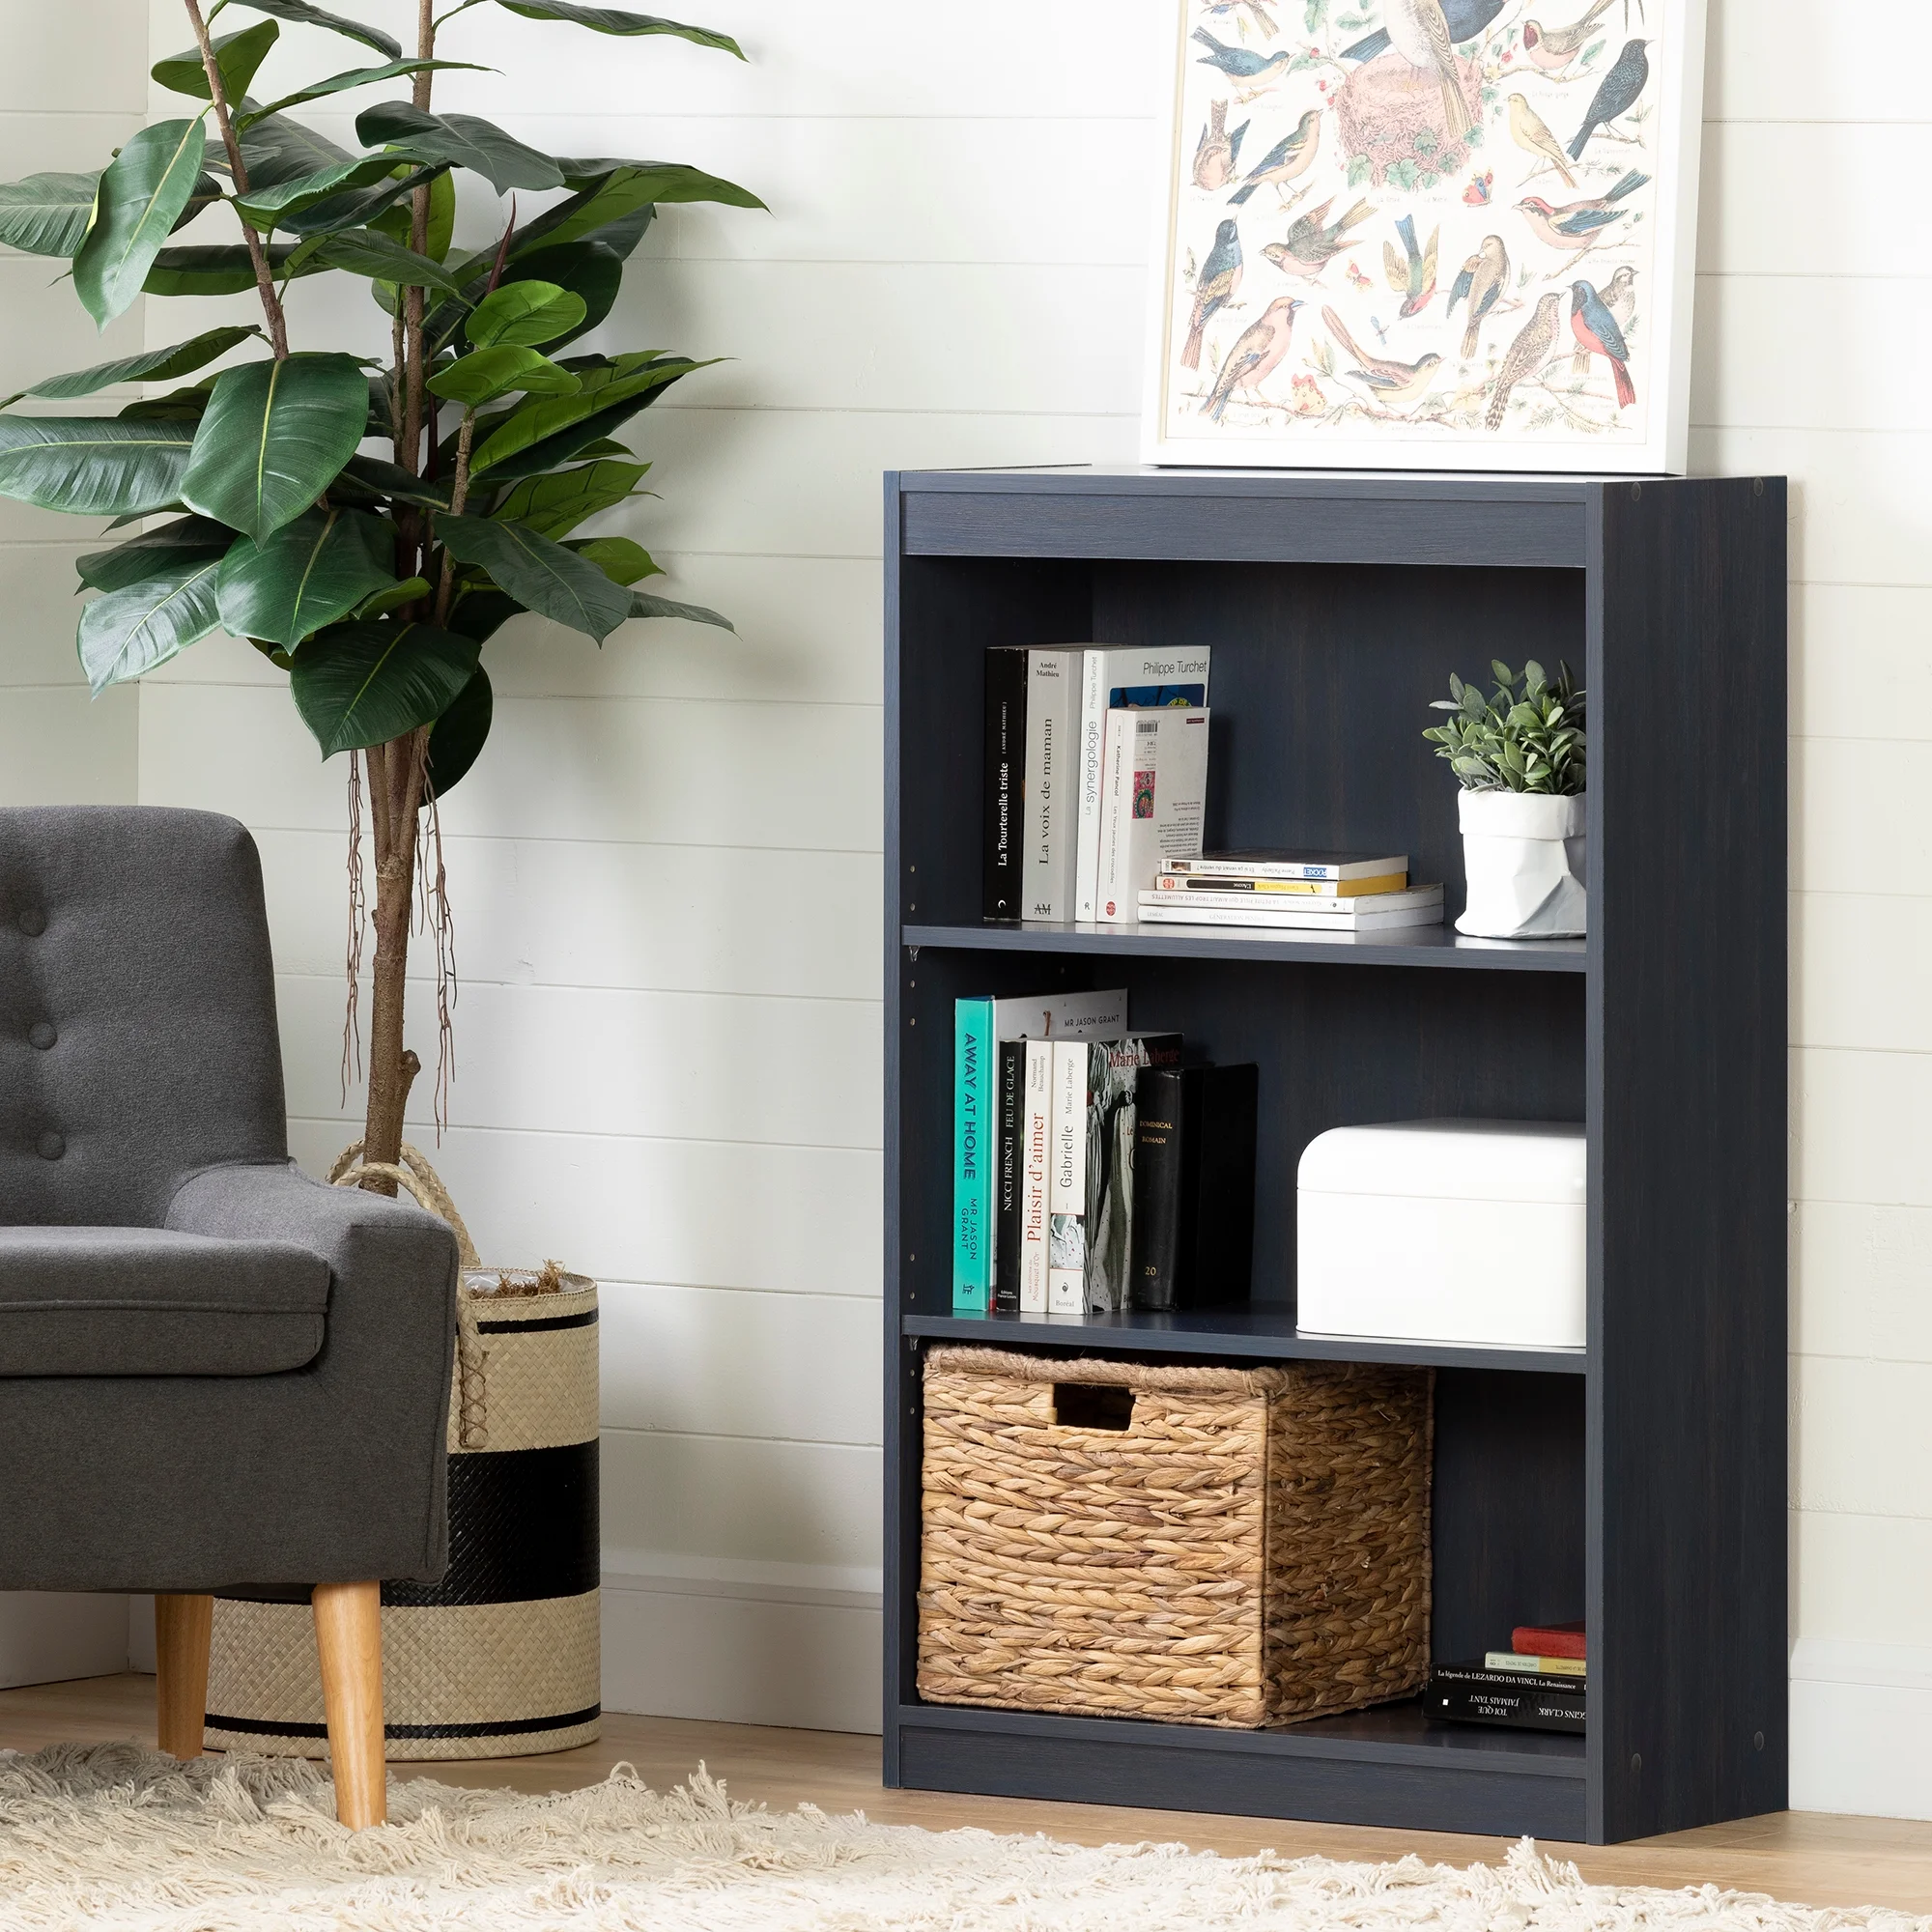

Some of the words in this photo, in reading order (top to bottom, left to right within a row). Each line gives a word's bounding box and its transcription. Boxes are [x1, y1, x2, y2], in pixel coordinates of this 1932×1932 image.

[1143, 662, 1175, 676] Philippe
[1177, 660, 1208, 673] Turchet
[1043, 719, 1052, 775] maman
[1086, 721, 1099, 803] synergologie
[999, 762, 1009, 790] triste
[1040, 781, 1051, 800] de
[1085, 806, 1092, 815] La
[998, 793, 1009, 850] Tourterelle
[1039, 805, 1050, 838] voix
[998, 853, 1008, 867] La
[1039, 844, 1049, 865] La
[1303, 867, 1326, 877] POCKET
[1064, 1018, 1074, 1027] MR
[1075, 1016, 1096, 1027] JASON
[1098, 1014, 1120, 1024] GRANT
[964, 1033, 978, 1090] AWAY
[1109, 1050, 1140, 1067] Marie
[1143, 1047, 1179, 1065] Laberge
[1006, 1055, 1015, 1090] GLACE
[1065, 1058, 1074, 1090] Laberge
[964, 1093, 977, 1116] AT
[1006, 1092, 1014, 1106] DE
[1065, 1092, 1073, 1115] Marie
[1006, 1109, 1014, 1128] FEU
[1140, 1121, 1173, 1129] DOMINICAL
[963, 1121, 977, 1180] HOME
[1004, 1136, 1013, 1179] FRENCH
[1028, 1113, 1044, 1181] d'aimer
[1060, 1125, 1074, 1188] Gabrielle
[1004, 1180, 1012, 1211] NICCI
[970, 1198, 978, 1215] MR
[1026, 1186, 1042, 1242] Plaisir
[969, 1220, 978, 1260] JASON
[1145, 1265, 1157, 1276] 20
[1445, 1670, 1463, 1680] légende
[1471, 1672, 1505, 1683] LEZARDO
[1505, 1675, 1517, 1685] DA
[1546, 1680, 1577, 1690] Renaissance
[1468, 1694, 1489, 1704] TANT
[1477, 1706, 1495, 1716] QUE
[1495, 1707, 1508, 1717] TOI
[1538, 1707, 1564, 1718] CLARK
